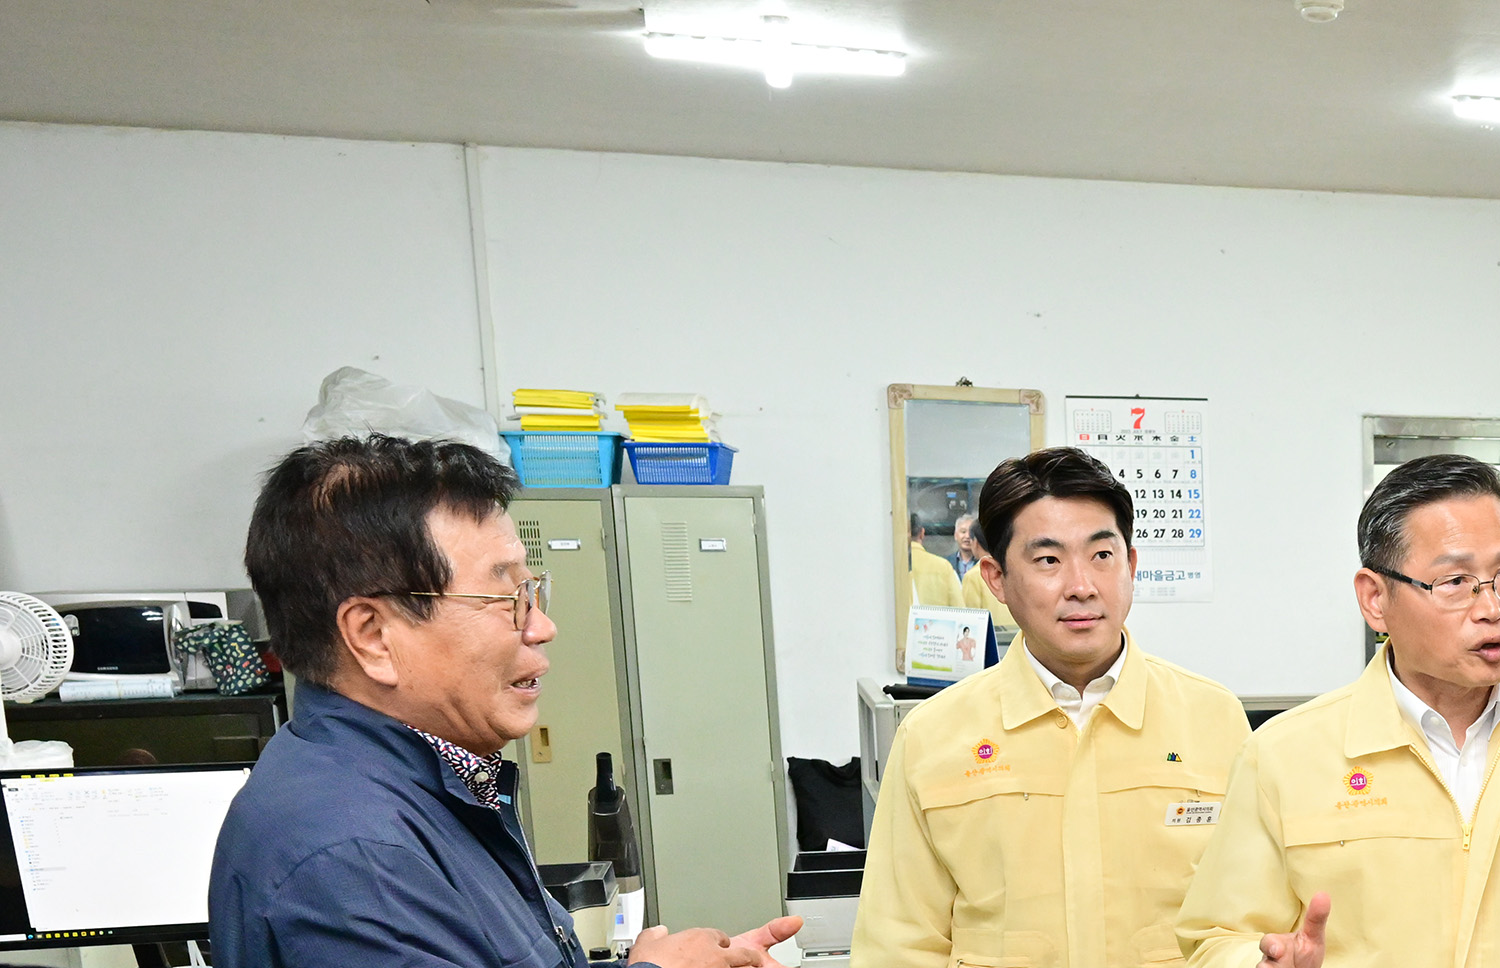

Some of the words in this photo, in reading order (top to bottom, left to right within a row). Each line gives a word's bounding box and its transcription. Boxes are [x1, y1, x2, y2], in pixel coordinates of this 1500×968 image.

[1131, 407, 1145, 429] 7
[1190, 449, 1195, 459] 1
[1118, 469, 1125, 479] 4
[1136, 469, 1143, 479] 5
[1154, 469, 1161, 479] 6
[1172, 469, 1179, 479] 7
[1190, 470, 1197, 479] 8
[1134, 489, 1146, 499] 12
[1152, 489, 1164, 499] 13
[1170, 489, 1182, 499] 14
[1188, 489, 1200, 499] 15
[1136, 509, 1147, 518] 19
[1153, 509, 1166, 518] 20
[1172, 509, 1183, 518] 21
[1188, 509, 1201, 518] 22
[1136, 529, 1148, 538] 26
[1154, 529, 1166, 538] 27
[1171, 529, 1184, 538] 28
[1189, 529, 1202, 538] 29
